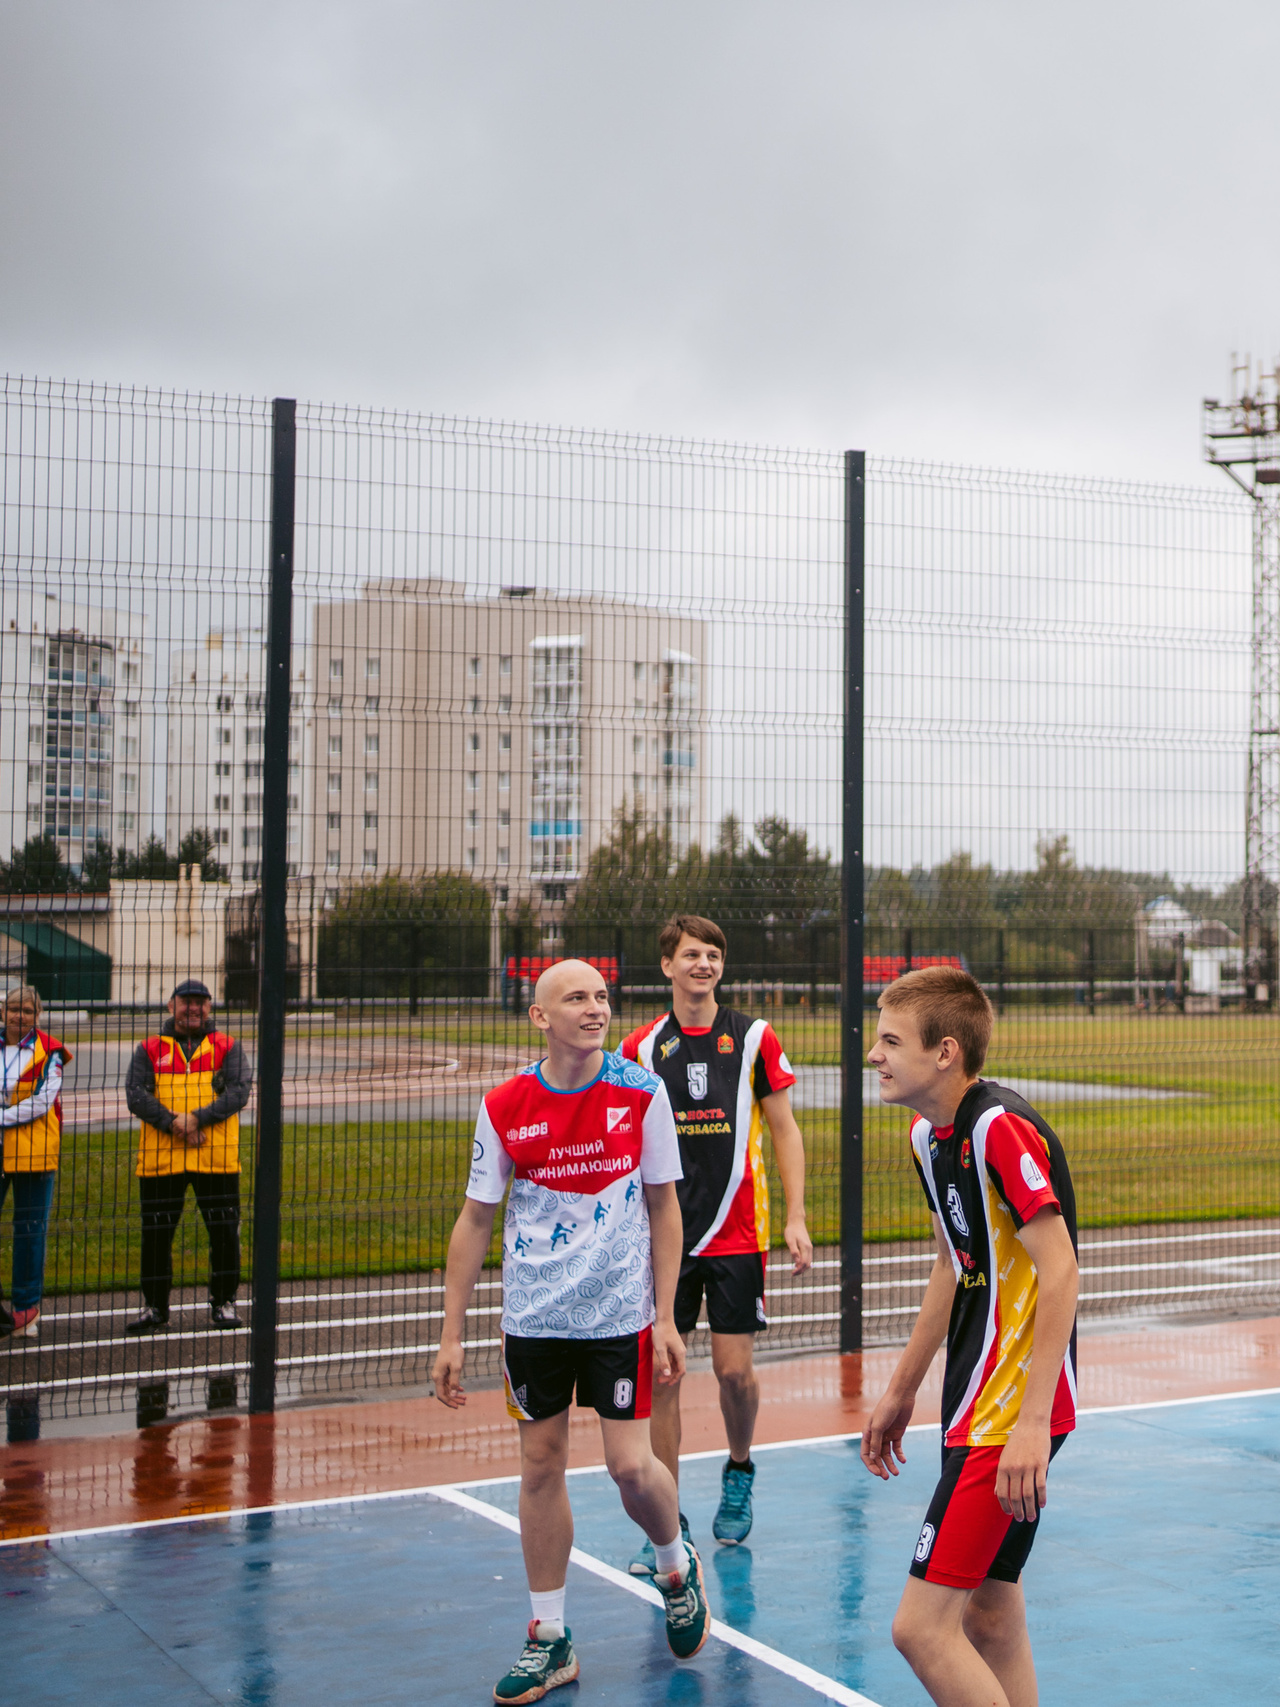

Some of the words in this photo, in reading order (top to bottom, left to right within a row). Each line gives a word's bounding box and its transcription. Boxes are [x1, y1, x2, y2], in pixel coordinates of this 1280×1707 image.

[687, 1062, 708, 1100] 5
[519, 1121, 548, 1140] ВФВ
[548, 1139, 604, 1160] ЛУЧШИЙ
[946, 1183, 970, 1237] 3
[613, 1377, 634, 1409] 8
[914, 1522, 936, 1562] 3
